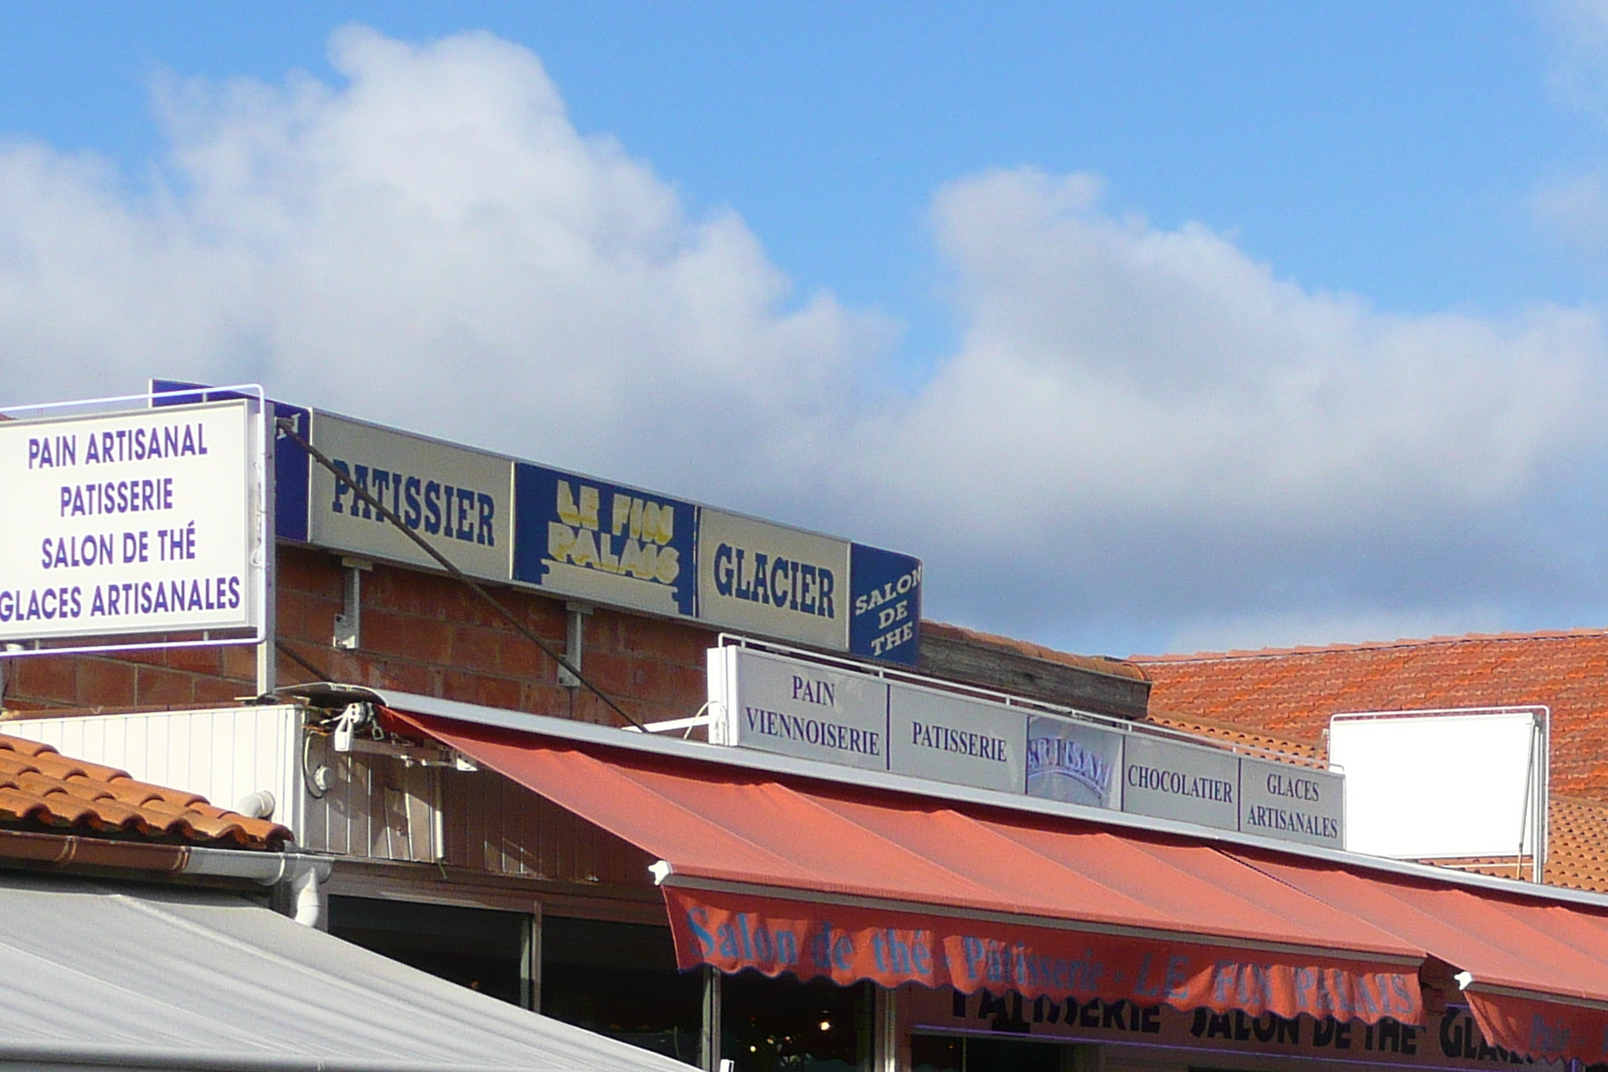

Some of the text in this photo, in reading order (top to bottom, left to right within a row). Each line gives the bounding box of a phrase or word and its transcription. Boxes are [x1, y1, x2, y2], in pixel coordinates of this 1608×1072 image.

[28, 423, 208, 469] PAIN ARTISANAL
[60, 478, 173, 517] PATISSERIE
[332, 458, 496, 547] PATISSIER
[557, 479, 675, 546] LE FIN
[42, 521, 196, 570] SALON DE THÉ
[547, 521, 680, 584] PALAIS
[0, 575, 241, 623] GLACES ARTISANALES
[713, 541, 836, 620] GLACIER
[854, 563, 922, 616] SALON
[877, 599, 909, 630] DE
[870, 619, 914, 657] THE
[792, 675, 836, 707] PAIN
[745, 707, 881, 757] VIENNOISERIE
[911, 720, 1008, 763] PATISSERIE
[1127, 763, 1233, 804] CHOCOLATIER
[1266, 773, 1320, 802] GLACES
[1247, 805, 1338, 839] ARTISANALES
[686, 905, 1414, 1016] Salon de thé Pâtisserie LE FIN PALAIS
[1530, 1014, 1571, 1053] Pain
